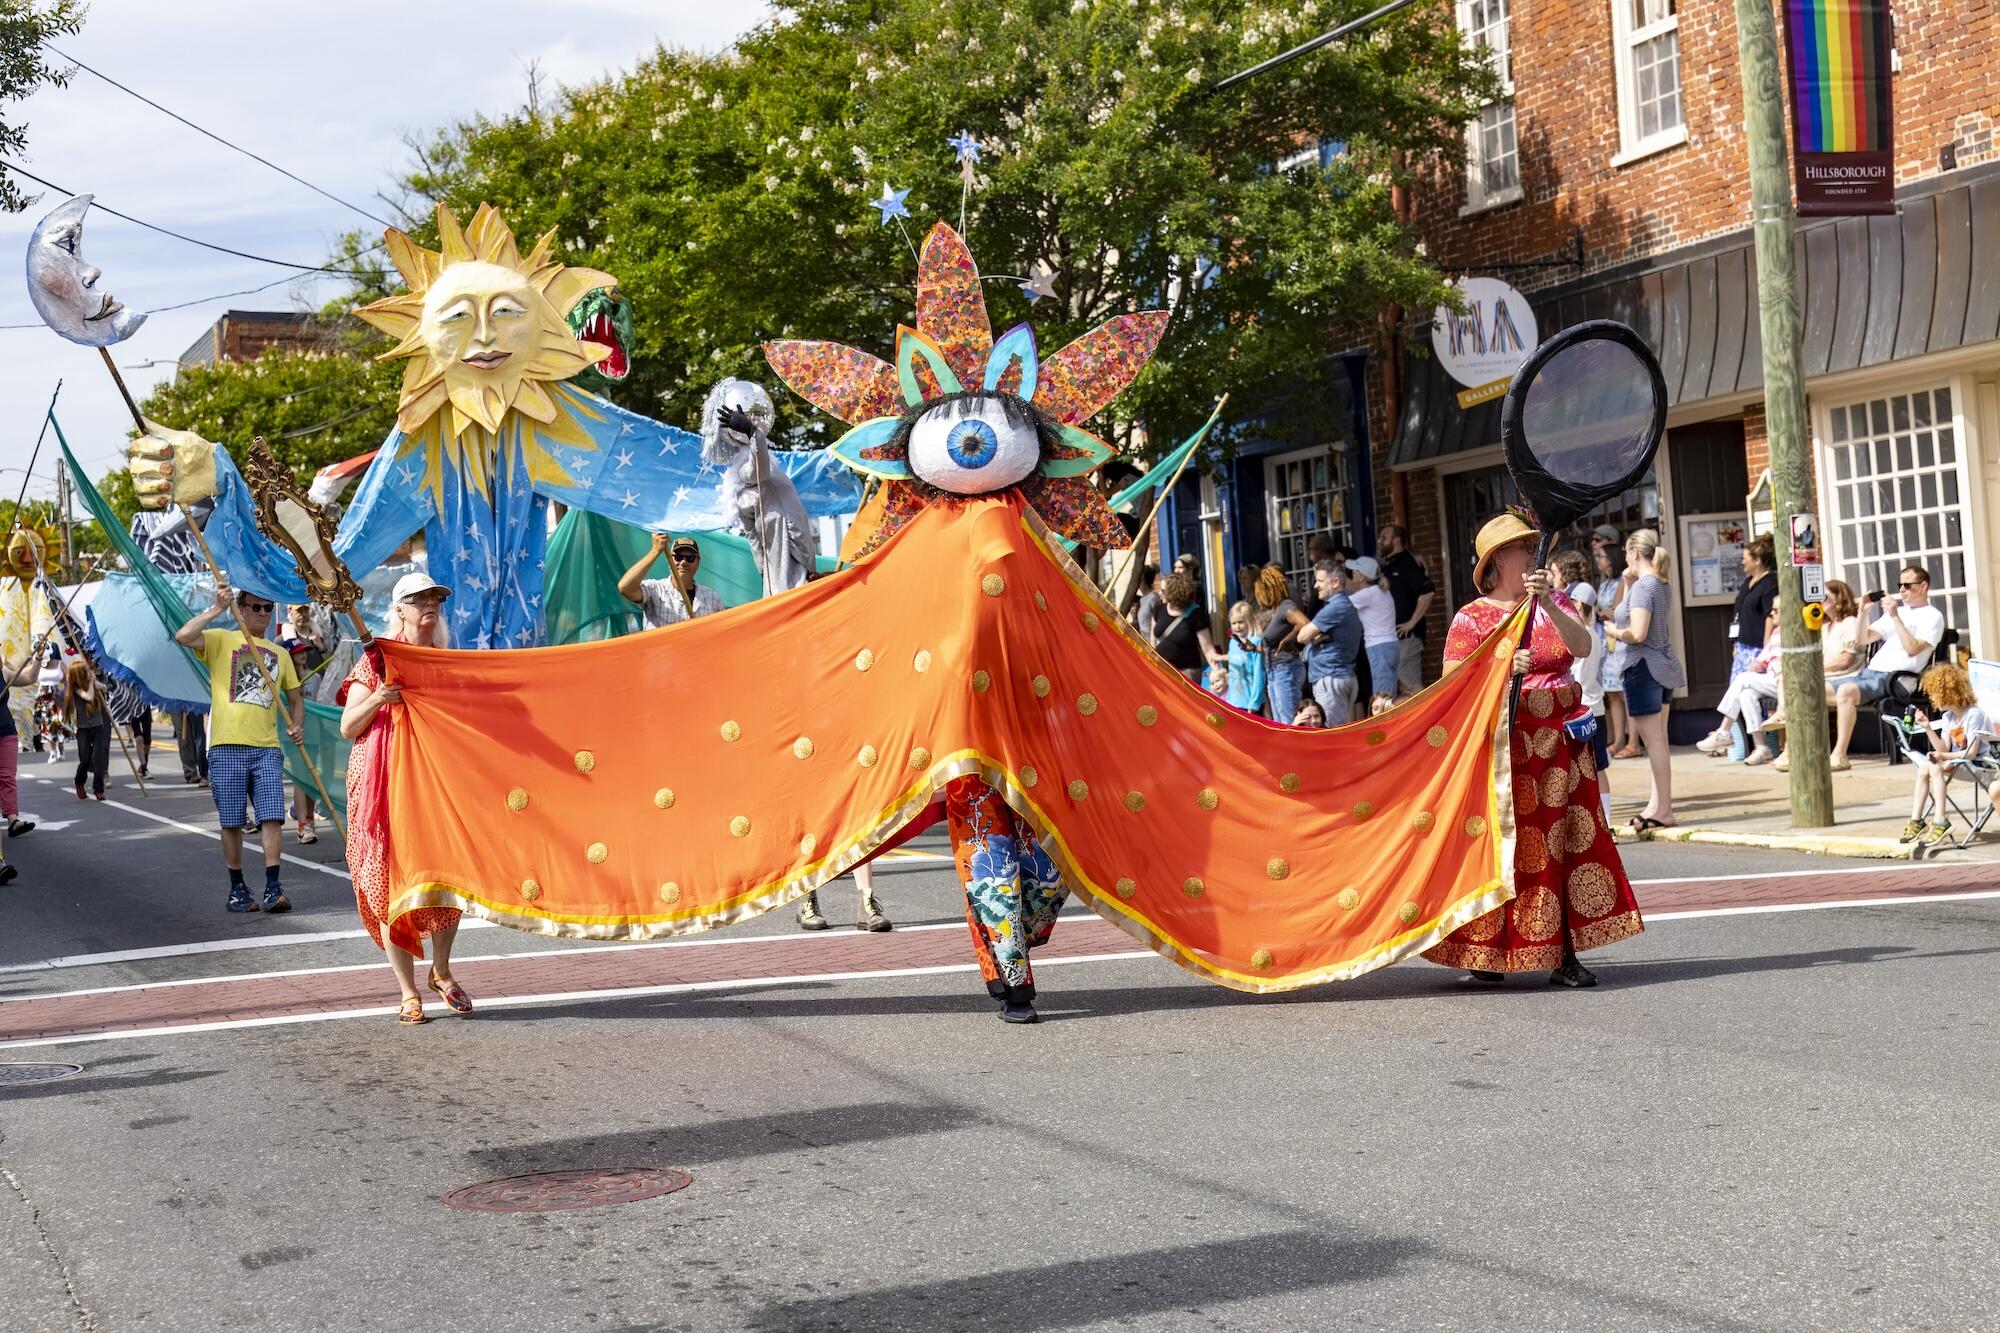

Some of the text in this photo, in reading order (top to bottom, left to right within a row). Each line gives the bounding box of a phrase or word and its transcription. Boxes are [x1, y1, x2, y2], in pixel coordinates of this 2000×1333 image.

[1805, 165, 1886, 179] HILLSBOROUGH
[1824, 187, 1854, 196] FOUNDED
[1465, 385, 1507, 401] GALLERY
[1657, 482, 1666, 536] 102
